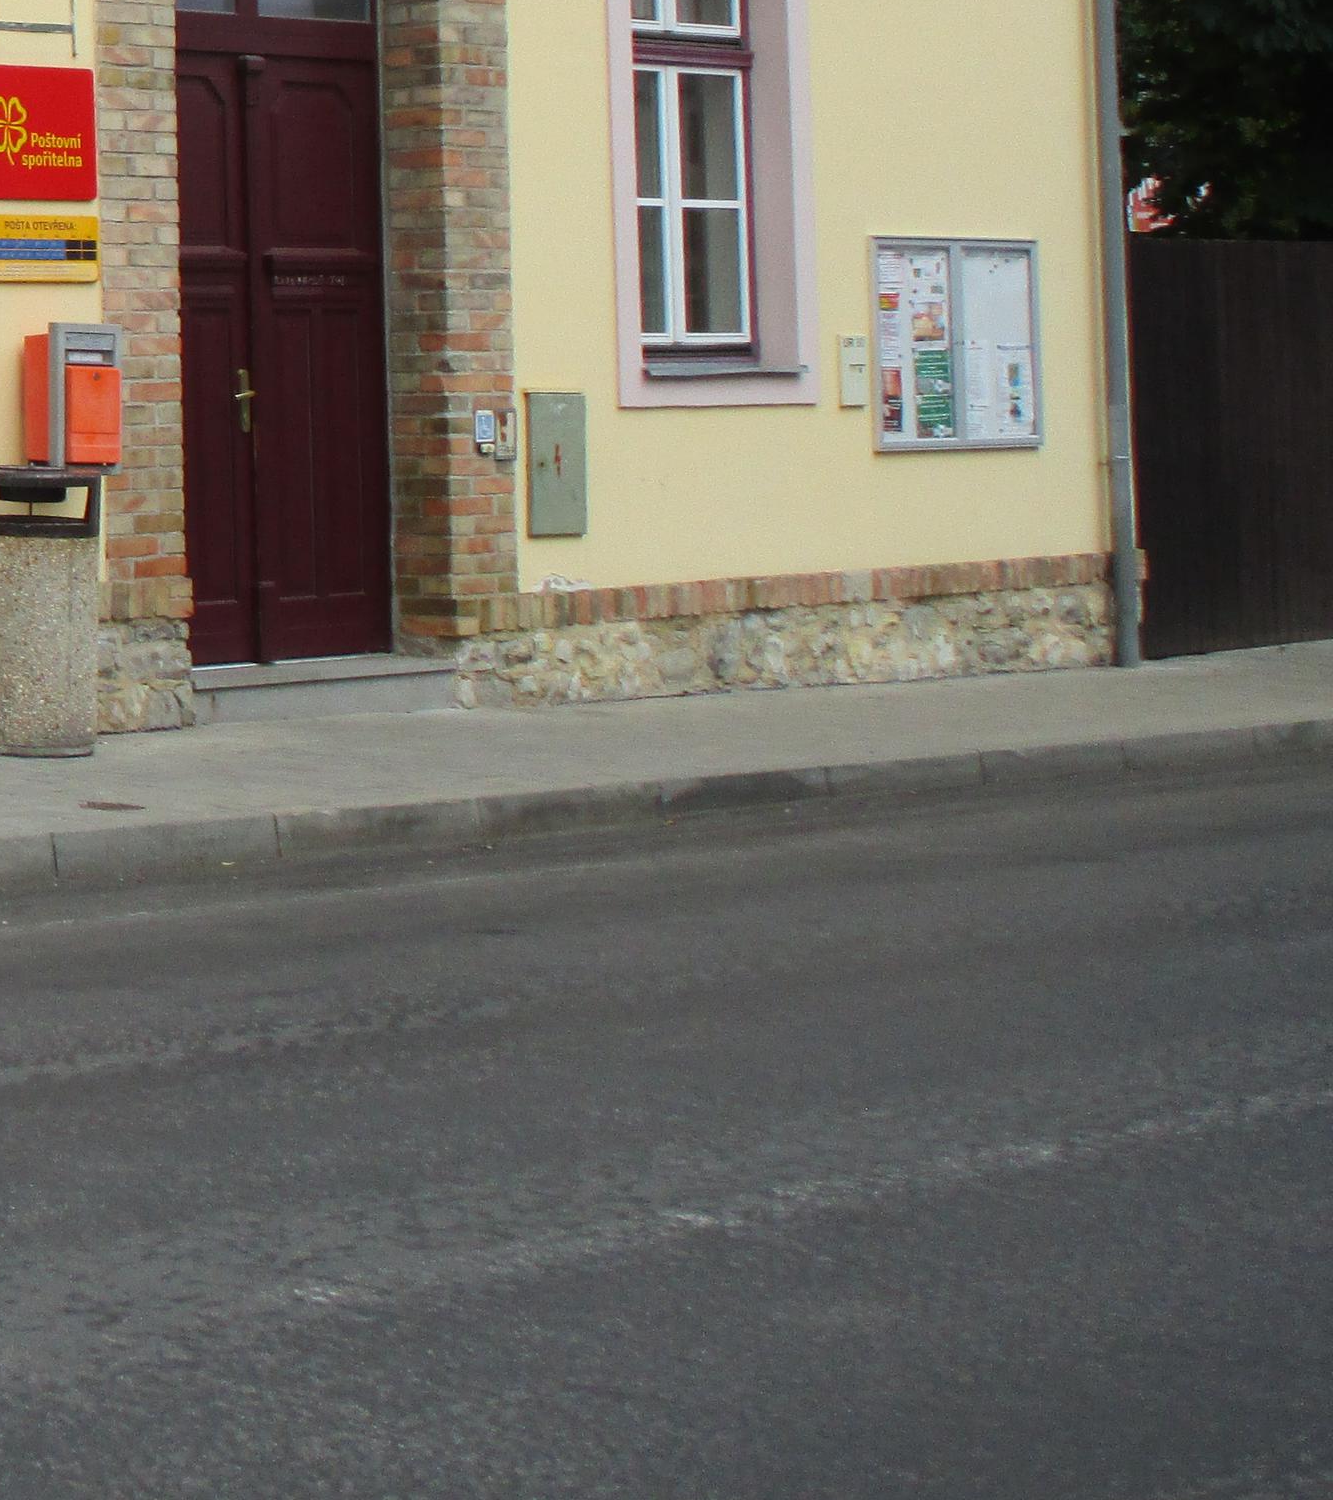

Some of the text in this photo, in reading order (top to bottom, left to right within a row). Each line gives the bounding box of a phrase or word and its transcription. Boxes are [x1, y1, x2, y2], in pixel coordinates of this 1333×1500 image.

[30, 132, 82, 149] Poštovní
[21, 150, 83, 170] spořitelna
[4, 219, 31, 231] POŠTA
